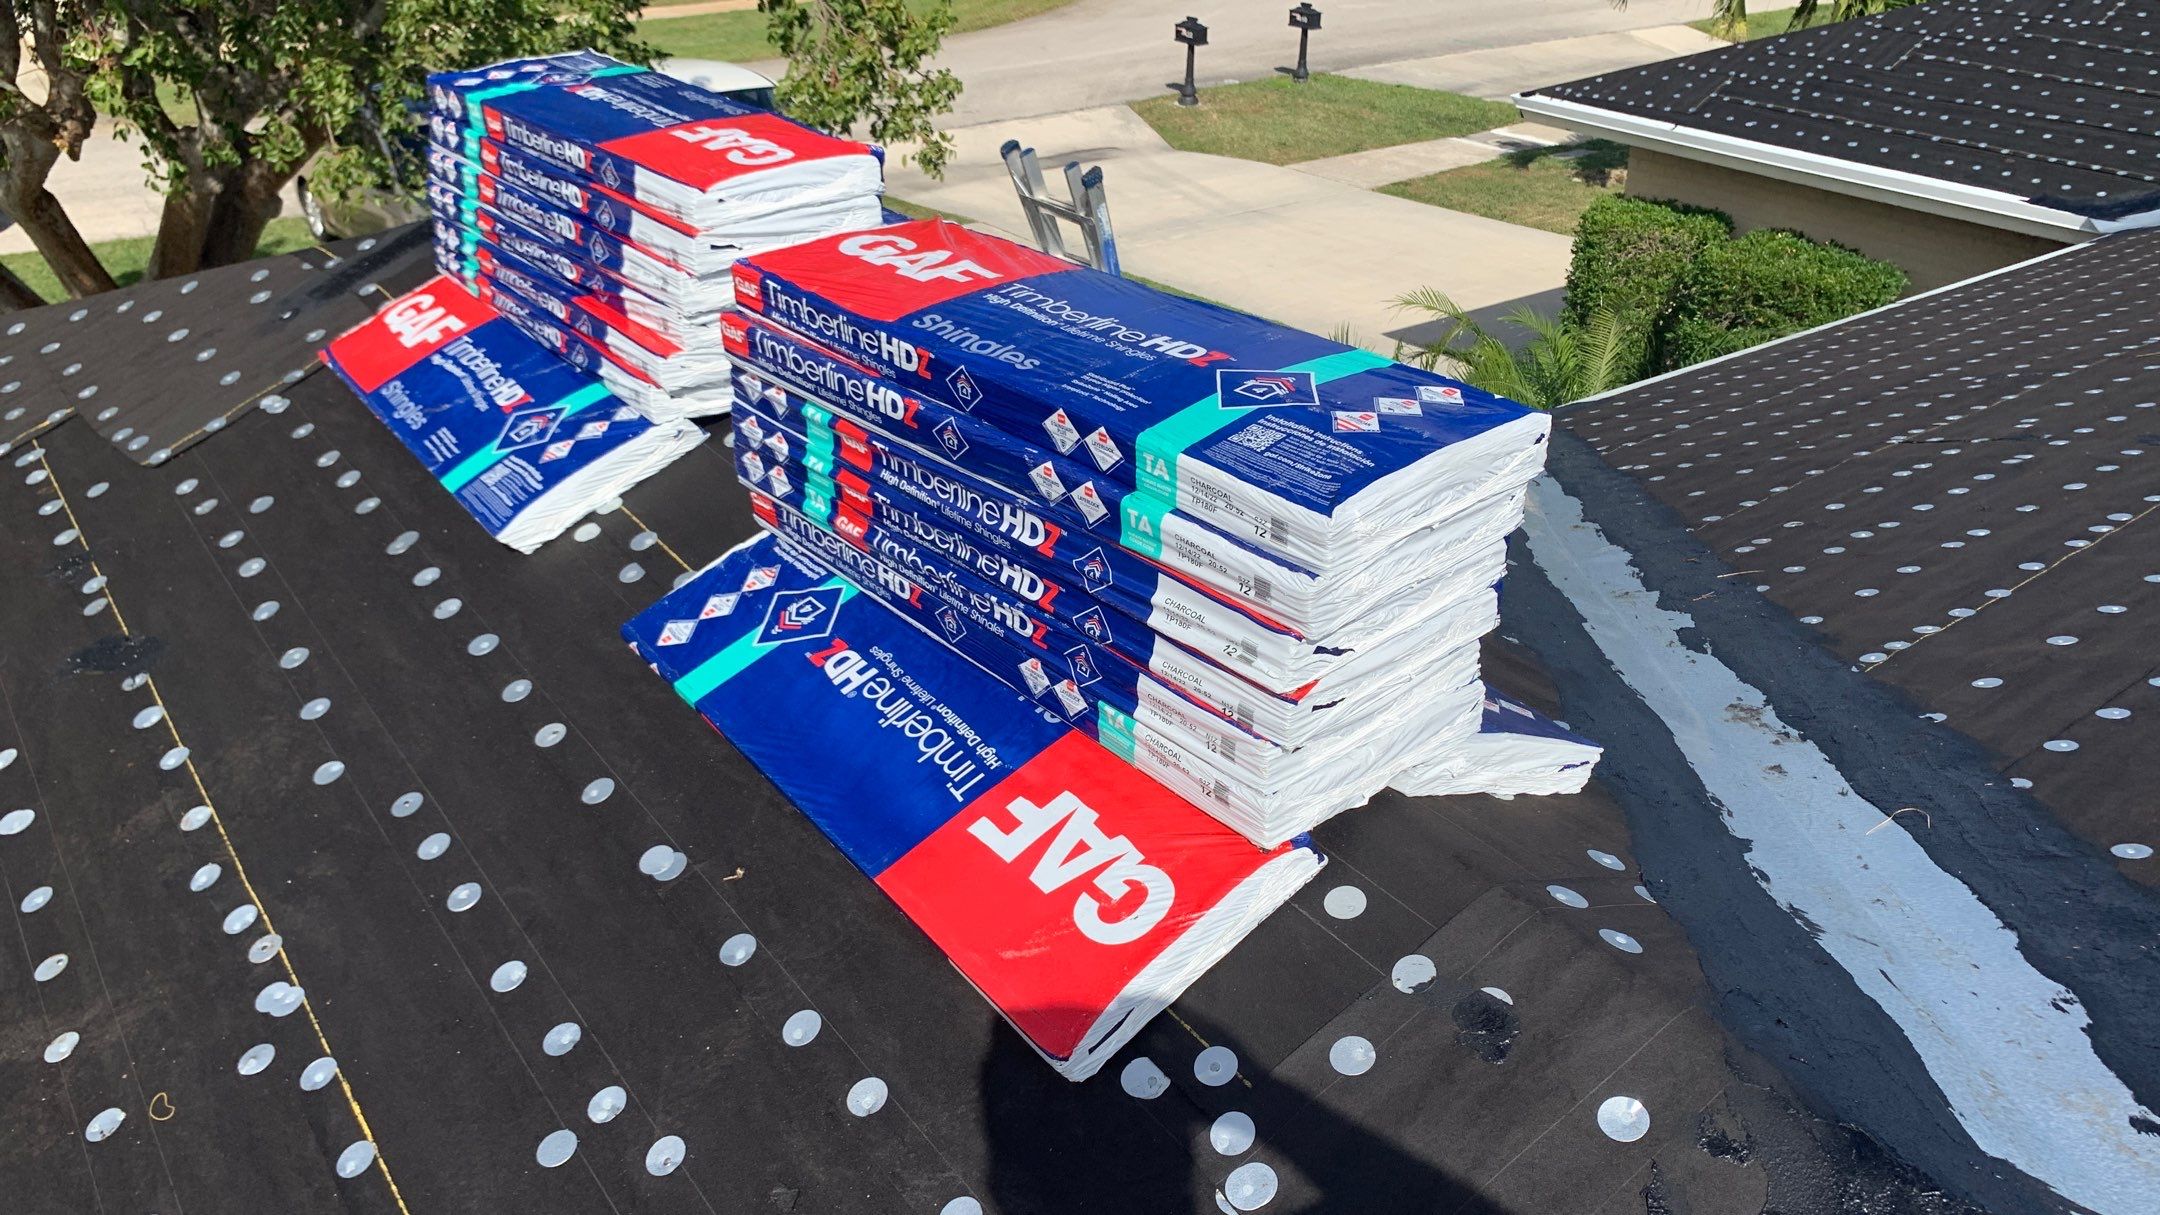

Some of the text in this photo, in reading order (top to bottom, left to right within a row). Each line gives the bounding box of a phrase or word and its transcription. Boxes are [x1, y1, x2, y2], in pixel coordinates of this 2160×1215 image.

[670, 126, 796, 166] GAF
[838, 234, 1003, 282] GAF
[734, 275, 760, 298] GAF
[384, 294, 468, 349] GAF
[721, 321, 746, 344] GAF
[983, 293, 1011, 307] High
[1104, 340, 1157, 362] Shingles
[912, 313, 1041, 371] Shingles
[860, 353, 897, 380] Shingles
[380, 380, 428, 431] Shingles
[807, 407, 823, 423] TA
[847, 399, 883, 425] Shingles
[1265, 413, 1315, 435] Installation
[808, 456, 824, 473] TA
[1142, 452, 1170, 482] TA
[1189, 476, 1234, 502] CHARCOAL
[1190, 485, 1219, 504] 12/14/22
[1224, 501, 1245, 517] 20:52
[879, 469, 900, 486] High
[940, 502, 973, 526] Lifetime
[973, 521, 1012, 551] Shingles
[1126, 508, 1154, 537] TA
[1190, 496, 1268, 539] TP180F 12
[1174, 533, 1217, 560] CHARCOAL
[1175, 542, 1202, 560] 12/14/22
[1208, 558, 1228, 575] 20:52
[1237, 582, 1252, 597] 12
[938, 587, 969, 614] Lifetime
[969, 608, 1005, 638] Shingles
[1163, 597, 1208, 624] CHARCOAL
[1165, 612, 1192, 631] TP180F
[869, 645, 905, 678] Shingles
[1222, 643, 1238, 657] 12
[1161, 660, 1204, 687] CHARCOAL
[901, 675, 937, 707] Lifetime
[1221, 706, 1235, 719] 12
[976, 745, 1001, 770] High
[1144, 733, 1184, 763] CHARCOAL
[1205, 741, 1218, 754] 12
[1200, 785, 1213, 798] 12
[966, 789, 1176, 946] GAF
